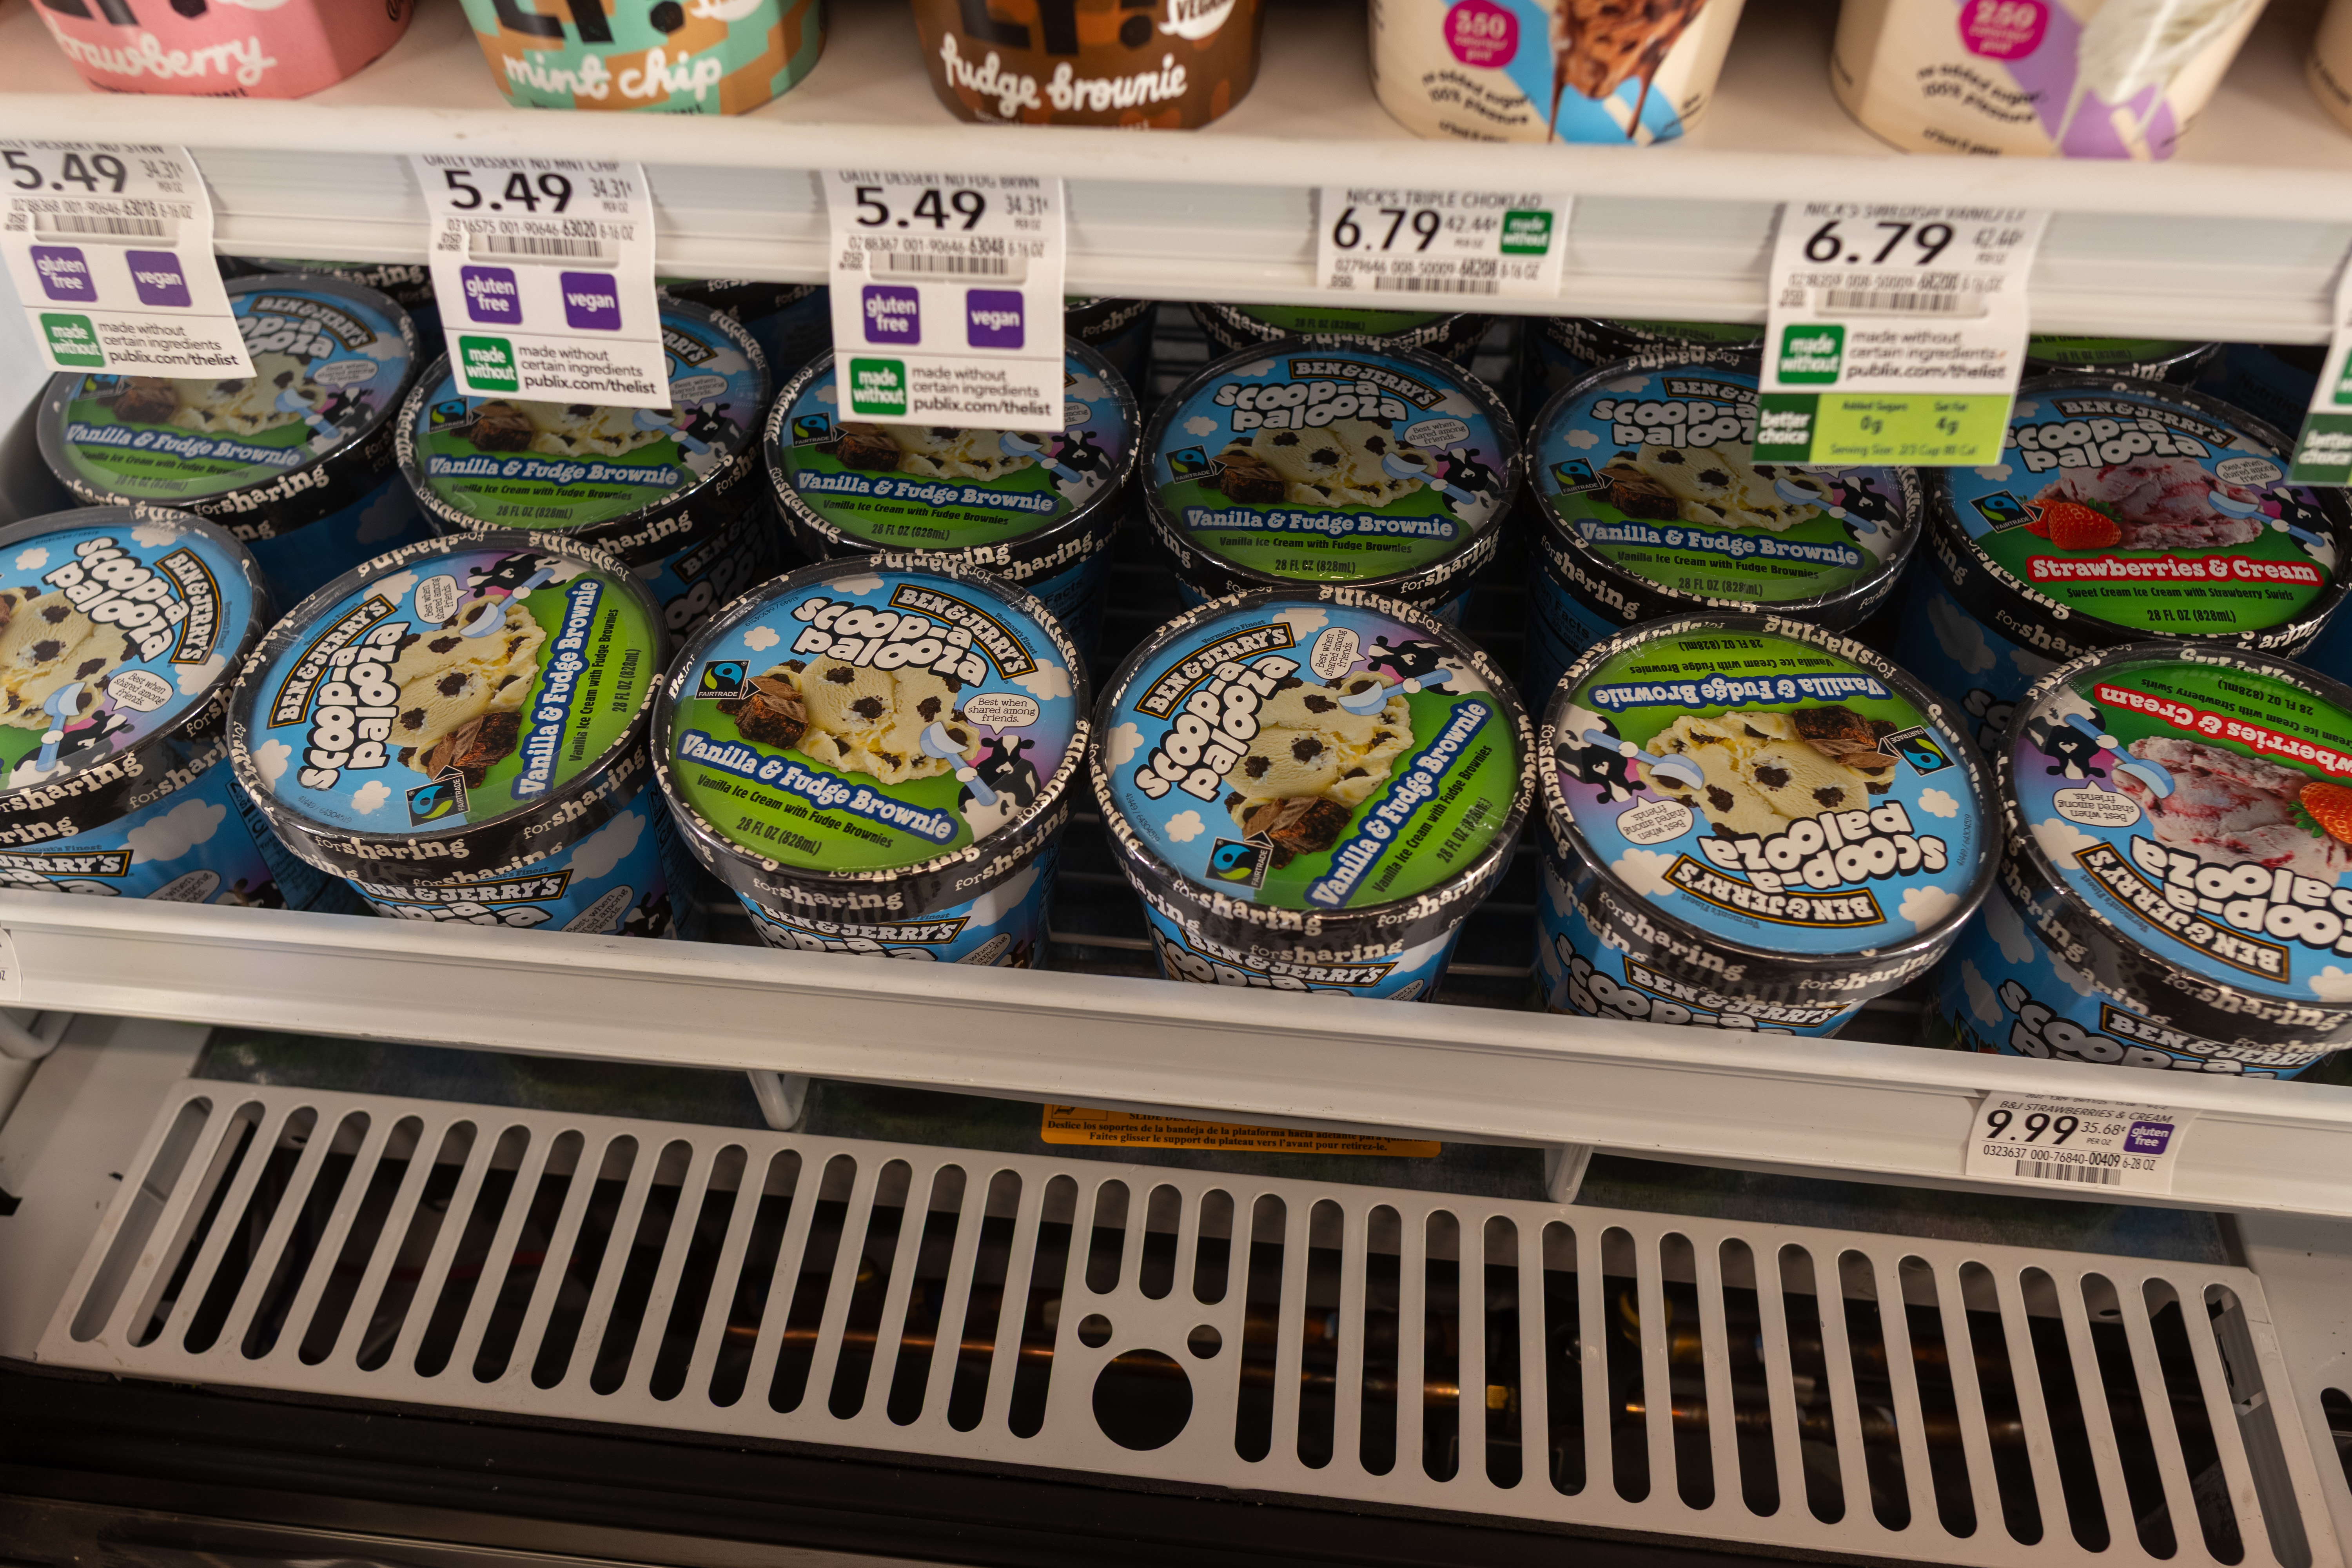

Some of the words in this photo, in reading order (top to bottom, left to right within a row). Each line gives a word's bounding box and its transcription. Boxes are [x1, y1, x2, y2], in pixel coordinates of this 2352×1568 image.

[504, 52, 611, 100] mint
[619, 47, 722, 102] chip
[940, 32, 1041, 117] fudge
[1047, 53, 1187, 111] brownie
[1, 151, 126, 194] 5.49
[445, 169, 573, 213] 5.49
[856, 186, 985, 230] 5.49
[1333, 207, 1441, 251] 6.79
[1804, 220, 1955, 266] 6.79
[37, 256, 86, 275] gluten
[51, 274, 83, 290] free
[135, 271, 182, 289] vegan
[466, 276, 515, 297] gluten
[477, 295, 509, 312] free
[567, 293, 614, 312] vegan
[866, 294, 916, 317] gluten
[876, 315, 908, 332] free
[971, 310, 1019, 330] vegan
[51, 325, 88, 339] made
[51, 340, 102, 356] without
[519, 346, 556, 358] made
[559, 347, 608, 361] without
[1789, 333, 1836, 353] made
[109, 352, 239, 365] publix.com/thelist
[468, 346, 506, 364] made
[1781, 355, 1840, 372] without
[466, 363, 516, 380] without
[522, 361, 566, 372] certain
[569, 364, 642, 379] ingredients
[859, 368, 897, 387] made
[1847, 363, 2005, 380] publix.com/thelist
[525, 376, 656, 394] publix.com/thelist
[853, 385, 905, 404] without
[914, 397, 1050, 416] publix.com/thelist
[1761, 411, 1811, 428] better
[795, 436, 830, 445] FAIRTRADE
[1758, 430, 1808, 445] choice
[430, 458, 499, 478] Vanilla
[502, 461, 519, 475] &
[522, 462, 584, 484] Fudge
[587, 465, 679, 485] Brownie
[798, 473, 870, 494] Vanilla
[873, 481, 893, 495] &
[895, 483, 958, 505] Fudge
[960, 490, 1053, 512] Brownie
[1187, 510, 1264, 527] Vanilla
[1267, 513, 1287, 528] &
[1289, 514, 1354, 535] Fudge
[1357, 516, 1454, 537] Brownie
[1994, 516, 2031, 530] FAIRTRADE
[165, 553, 196, 586] BEN
[2033, 559, 2205, 578] Strawberries
[2208, 561, 2228, 577] &
[2234, 561, 2318, 582] Cream
[189, 581, 208, 595] &
[45, 561, 173, 661] palooza
[557, 581, 597, 649] Brownie
[180, 594, 213, 661] JERRY'S
[898, 589, 944, 615] BEN
[948, 607, 966, 626] &
[957, 614, 1028, 676] JERRY'S
[277, 686, 303, 722] BEN
[296, 666, 319, 681] &
[308, 600, 388, 668] JERRY'S
[799, 626, 986, 685] palooza
[544, 652, 583, 702] Fudge
[1145, 674, 1186, 715] BEN
[1184, 660, 1207, 678] &
[1200, 627, 1288, 671] JERRY'S
[350, 624, 408, 768] palooza
[1596, 683, 1699, 706] Brownie
[1702, 682, 1774, 704] Fudge
[1778, 679, 1796, 696] &
[1804, 676, 1884, 697] Vanilla
[543, 704, 564, 722] &
[968, 706, 1002, 714] shared
[1004, 707, 1035, 715] among
[2100, 687, 2194, 725] Cream
[982, 712, 1019, 722] friends.
[2198, 717, 2223, 734] &
[1181, 656, 1300, 801] palooza
[519, 720, 560, 795] Vanilla
[682, 734, 758, 775] Vanilla
[761, 761, 783, 779] &
[783, 767, 851, 806] Fudge
[848, 791, 953, 840] Brownie
[697, 775, 732, 794] Vanilla
[731, 785, 748, 799] Ice
[750, 789, 784, 811] Cream
[783, 801, 809, 819] with
[808, 809, 842, 830] Fudge
[842, 820, 893, 848] Brownies
[1312, 837, 1381, 907] Vanilla
[1374, 818, 1392, 837] &
[1386, 776, 1434, 827] Fudge
[1421, 704, 1488, 775] Brownie
[736, 816, 752, 830] 28
[751, 820, 763, 833] FL
[762, 826, 779, 840] OZ
[781, 830, 822, 856] (828mL)
[1701, 803, 1913, 869] palooza
[1675, 863, 1789, 918] JERRY'S
[2086, 850, 2190, 932] JERRY'S
[1787, 897, 1808, 917] &
[1811, 895, 1874, 920] BEN
[2191, 923, 2214, 943] &
[2211, 940, 2282, 972] BEN
[2000, 1101, 2023, 1109] B&J
[2024, 1103, 2113, 1118] STRAWBERRIES
[2129, 1112, 2173, 1123] CREAM
[1048, 1121, 1081, 1129] Deslice
[1099, 1123, 1138, 1132] soportes
[1167, 1125, 1204, 1135] bandeja
[1207, 1125, 1218, 1134] de
[1233, 1127, 1284, 1138] plataforma
[1288, 1130, 1312, 1138] hacia
[1987, 1110, 2078, 1145] 9.99
[2080, 1122, 2126, 1135] 35.68¢
[2131, 1127, 2169, 1138] gluten
[1120, 1133, 1151, 1143] glisser
[1163, 1135, 1201, 1145] support
[1219, 1138, 1254, 1146] plateau
[1279, 1139, 1312, 1148] l'avant
[1316, 1141, 1338, 1150] pour
[1342, 1142, 1387, 1151] retirez-le.
[2134, 1137, 2159, 1146] free
[1984, 1145, 2026, 1158] 0323637
[2031, 1149, 2120, 1167] 000-76840-00409
[2123, 1158, 2141, 1169] 6-28
[2143, 1160, 2155, 1171] OZ
